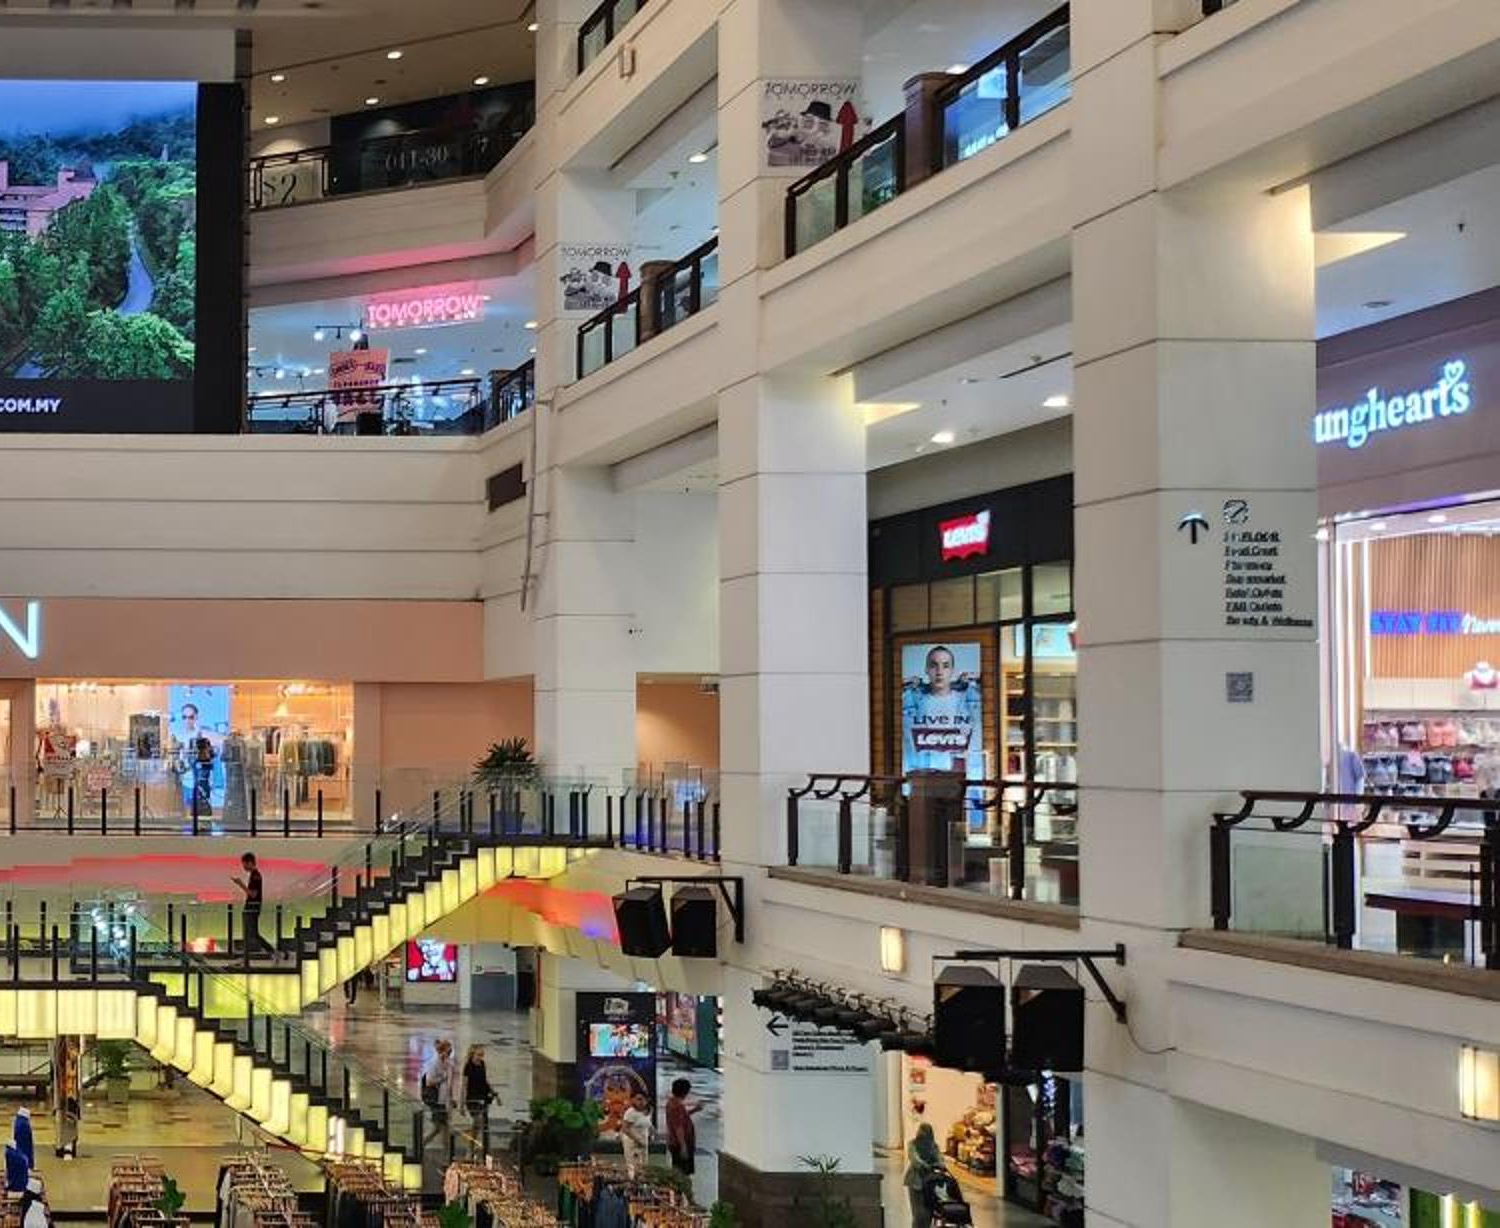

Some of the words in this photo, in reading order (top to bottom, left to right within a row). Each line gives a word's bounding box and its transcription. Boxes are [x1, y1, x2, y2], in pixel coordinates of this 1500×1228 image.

[368, 295, 480, 322] TOMORROW
[1315, 371, 1471, 448] unghearts
[953, 714, 970, 725] IN
